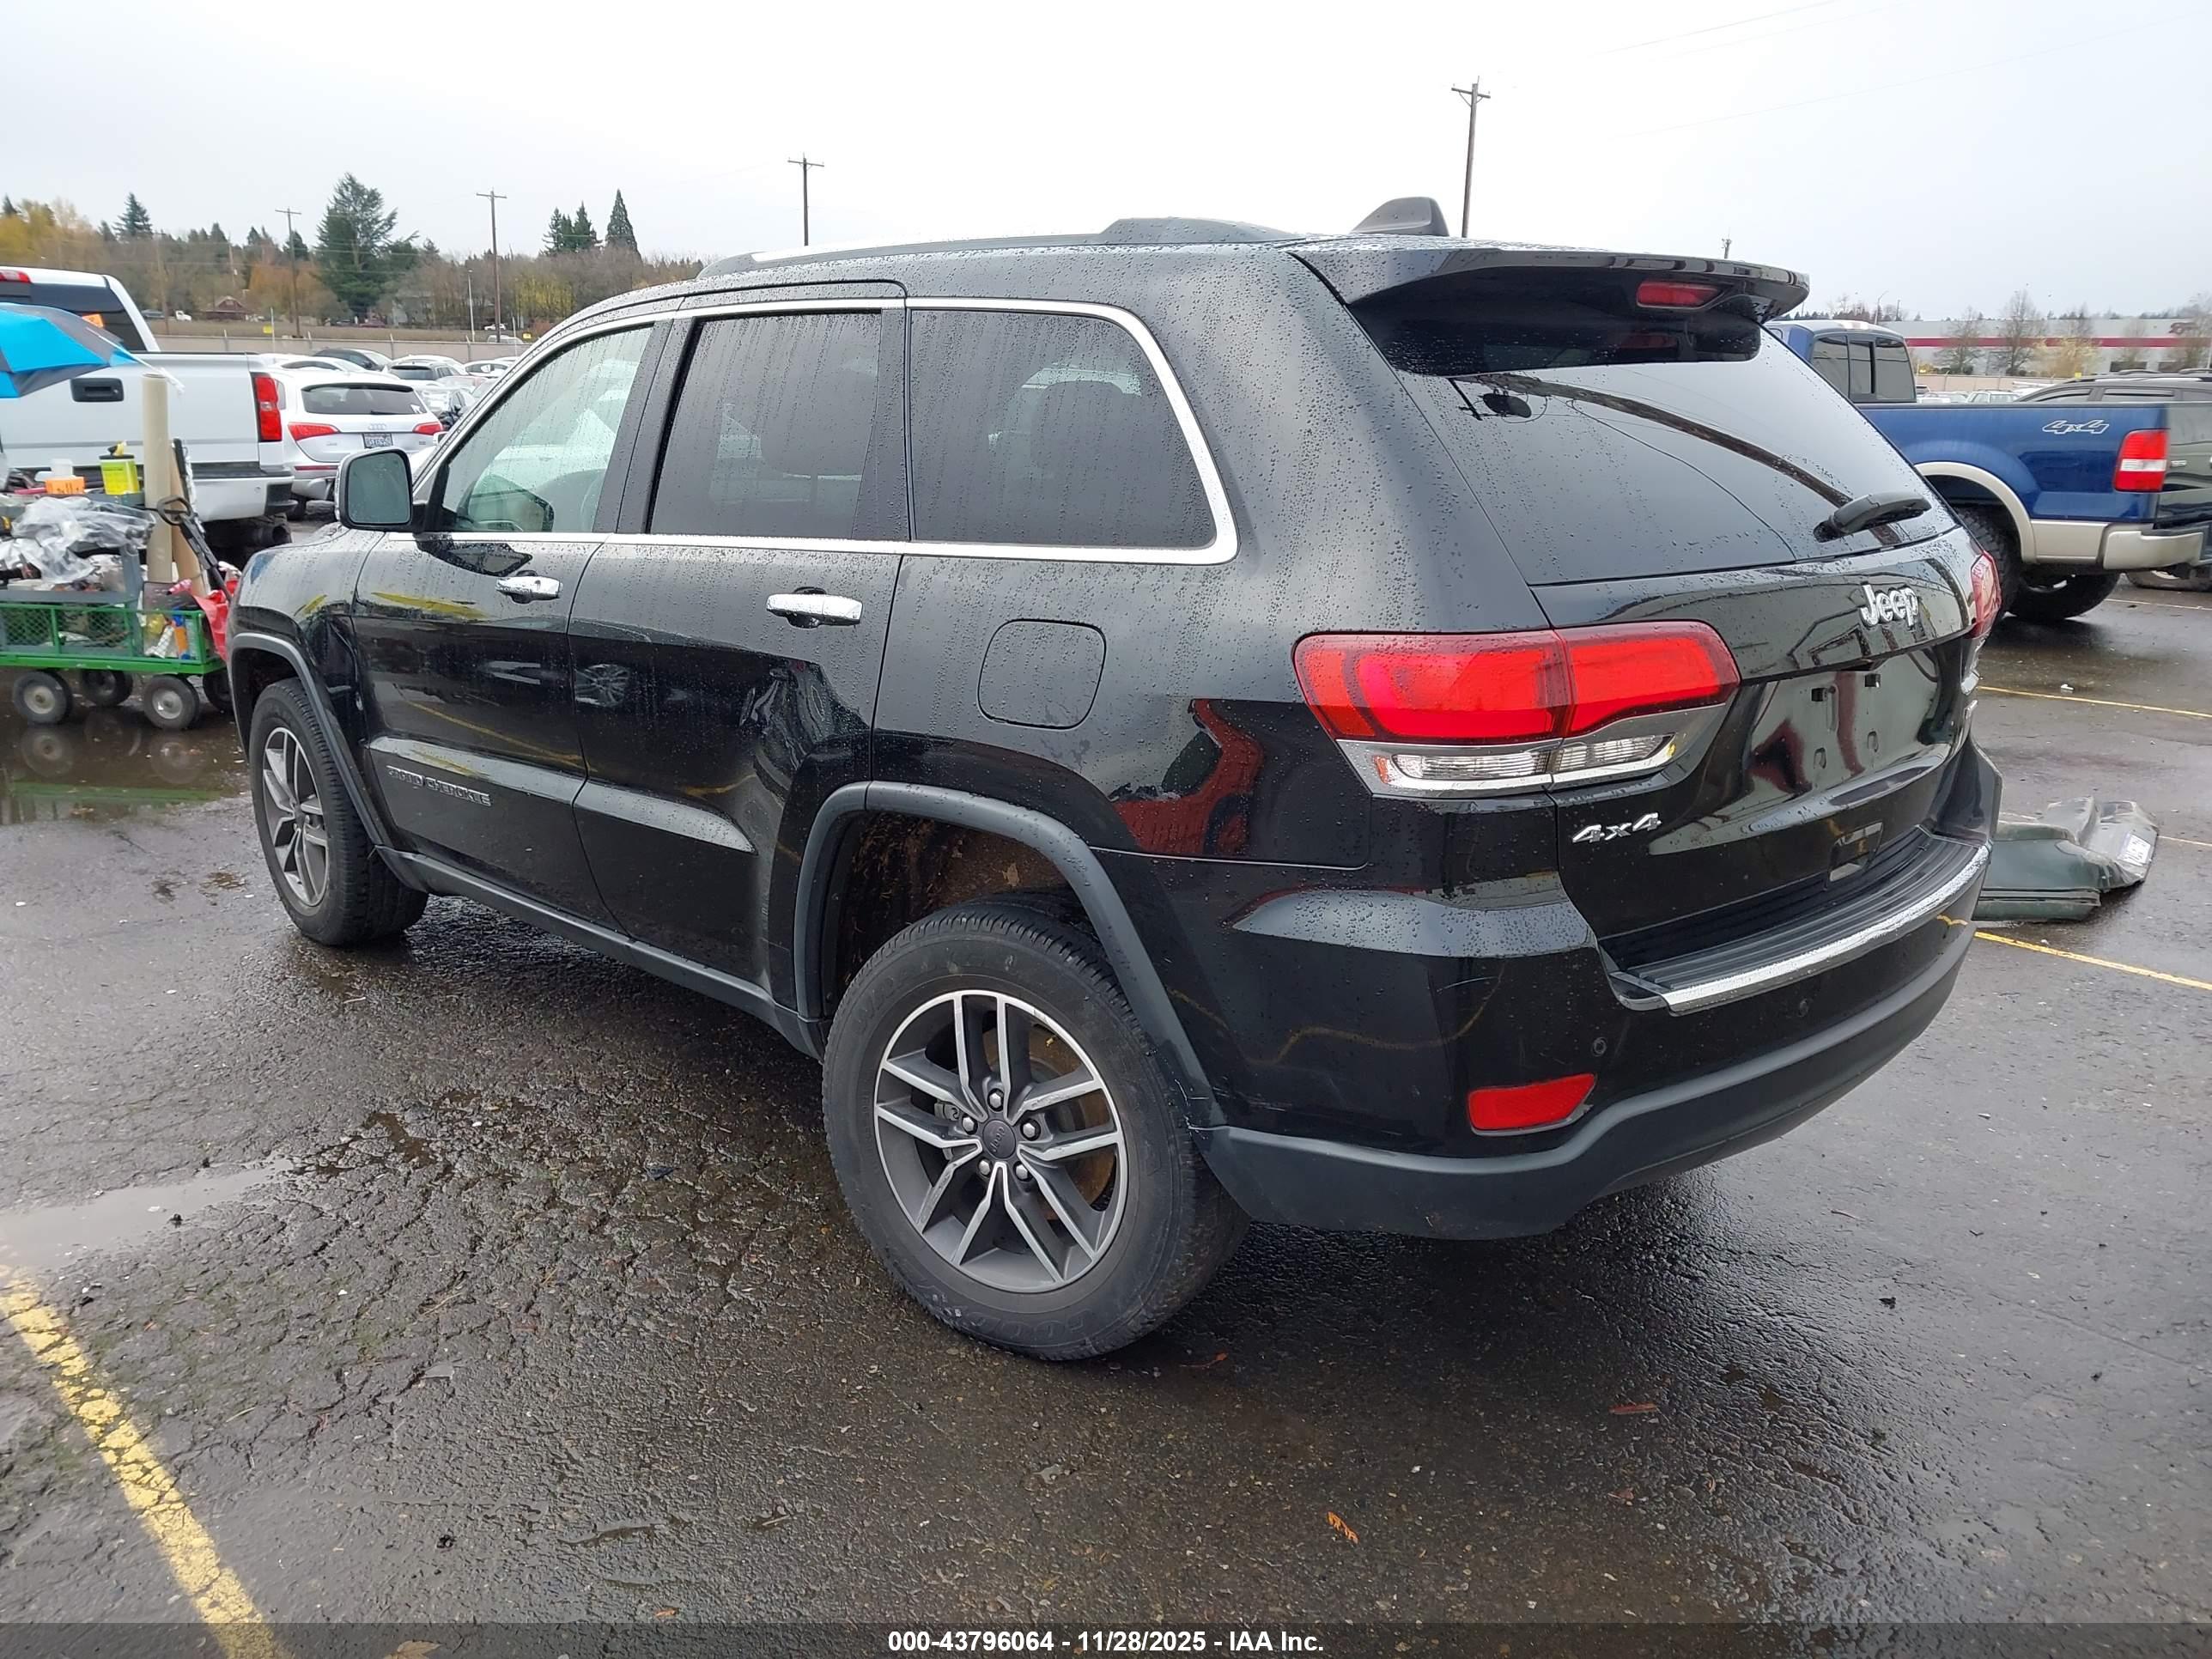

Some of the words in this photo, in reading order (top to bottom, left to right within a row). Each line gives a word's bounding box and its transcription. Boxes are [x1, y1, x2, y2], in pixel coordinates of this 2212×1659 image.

[2042, 419, 2110, 434] 4x4
[1859, 584, 1919, 628] Jeep
[1572, 811, 1662, 843] 4x4
